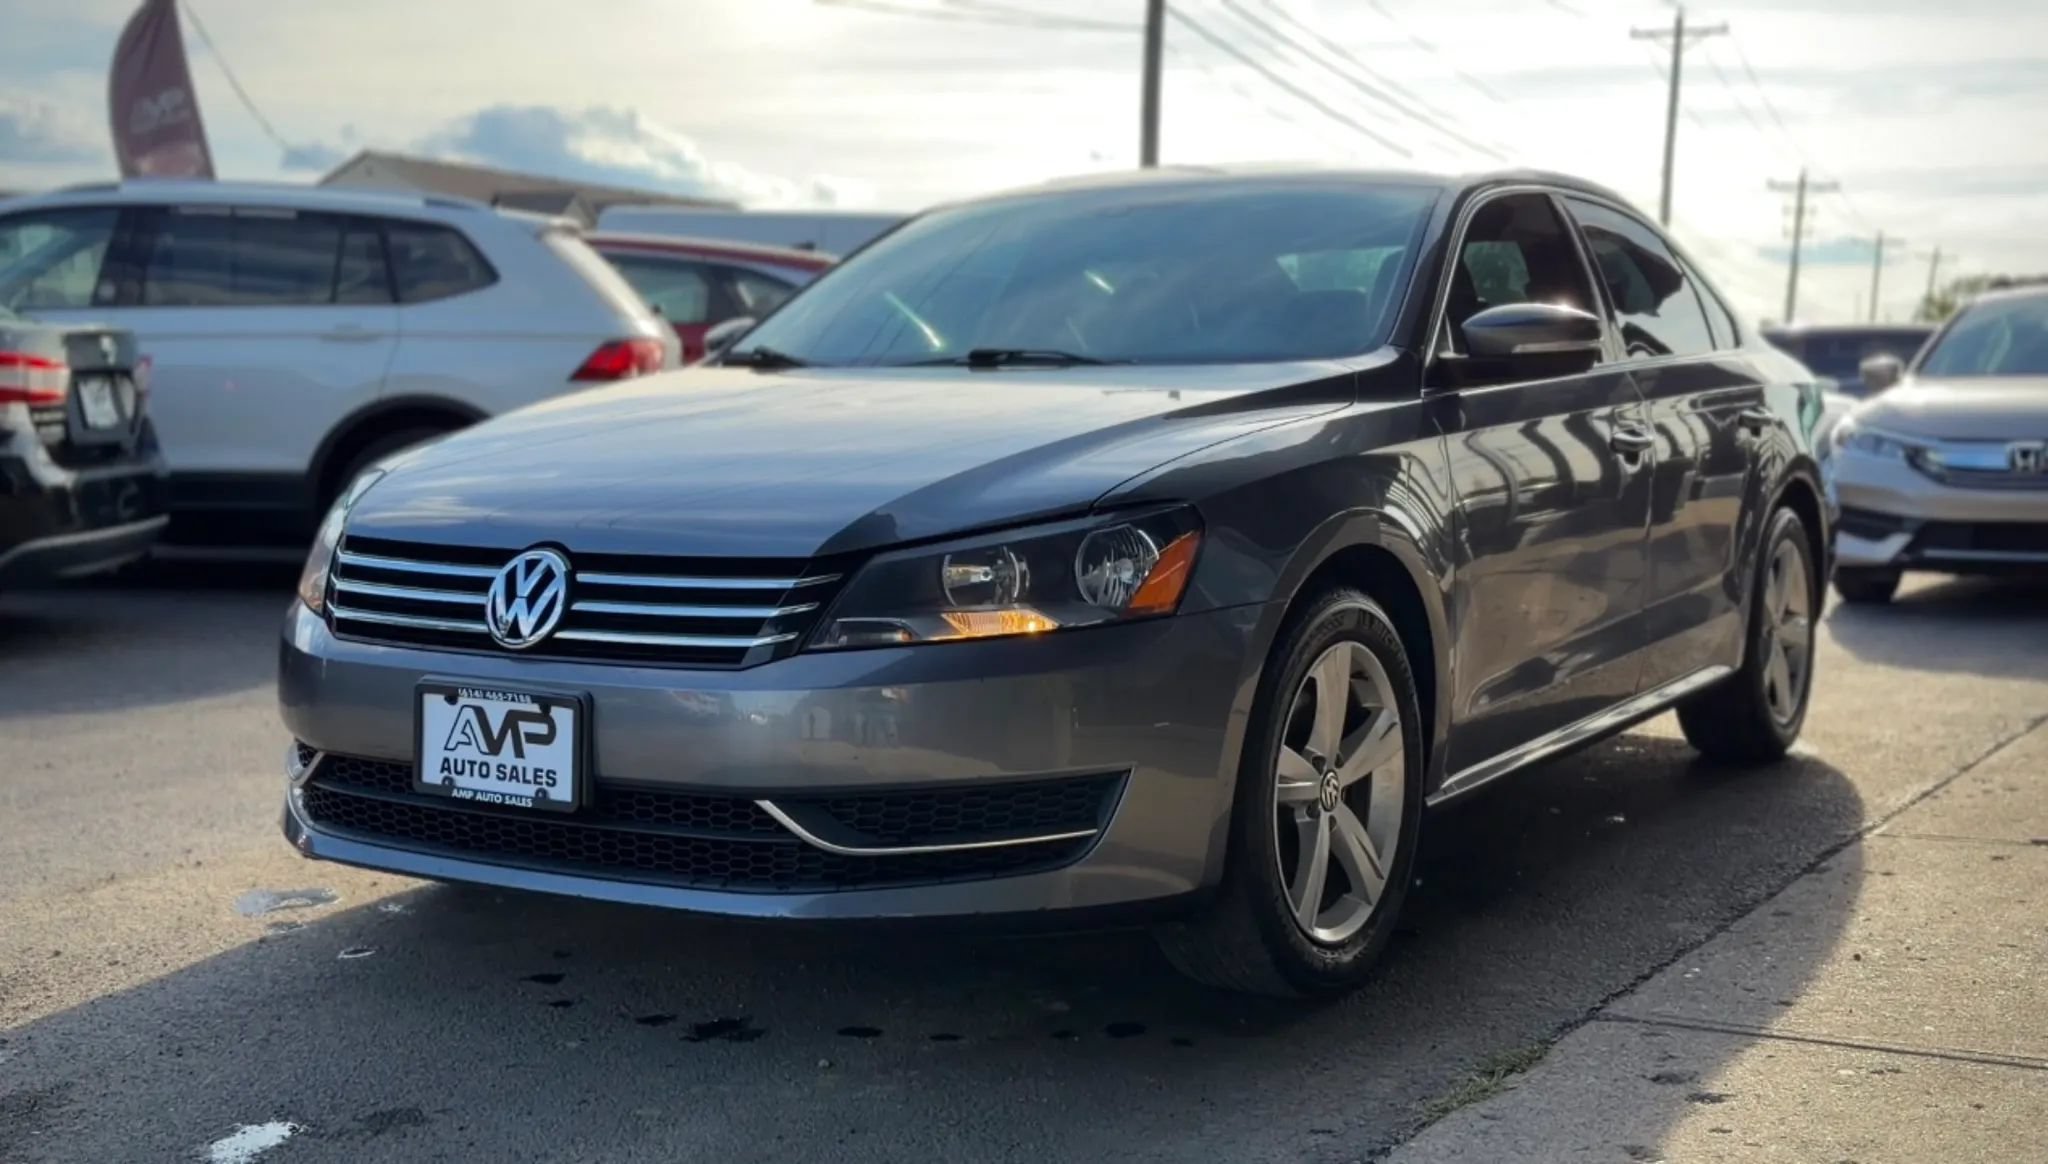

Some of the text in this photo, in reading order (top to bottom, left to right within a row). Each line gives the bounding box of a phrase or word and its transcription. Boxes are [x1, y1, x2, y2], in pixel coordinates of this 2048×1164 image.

[444, 704, 557, 759] AMP
[440, 757, 557, 787] AUTO SALES
[452, 788, 533, 808] AMP AUTO SALES
